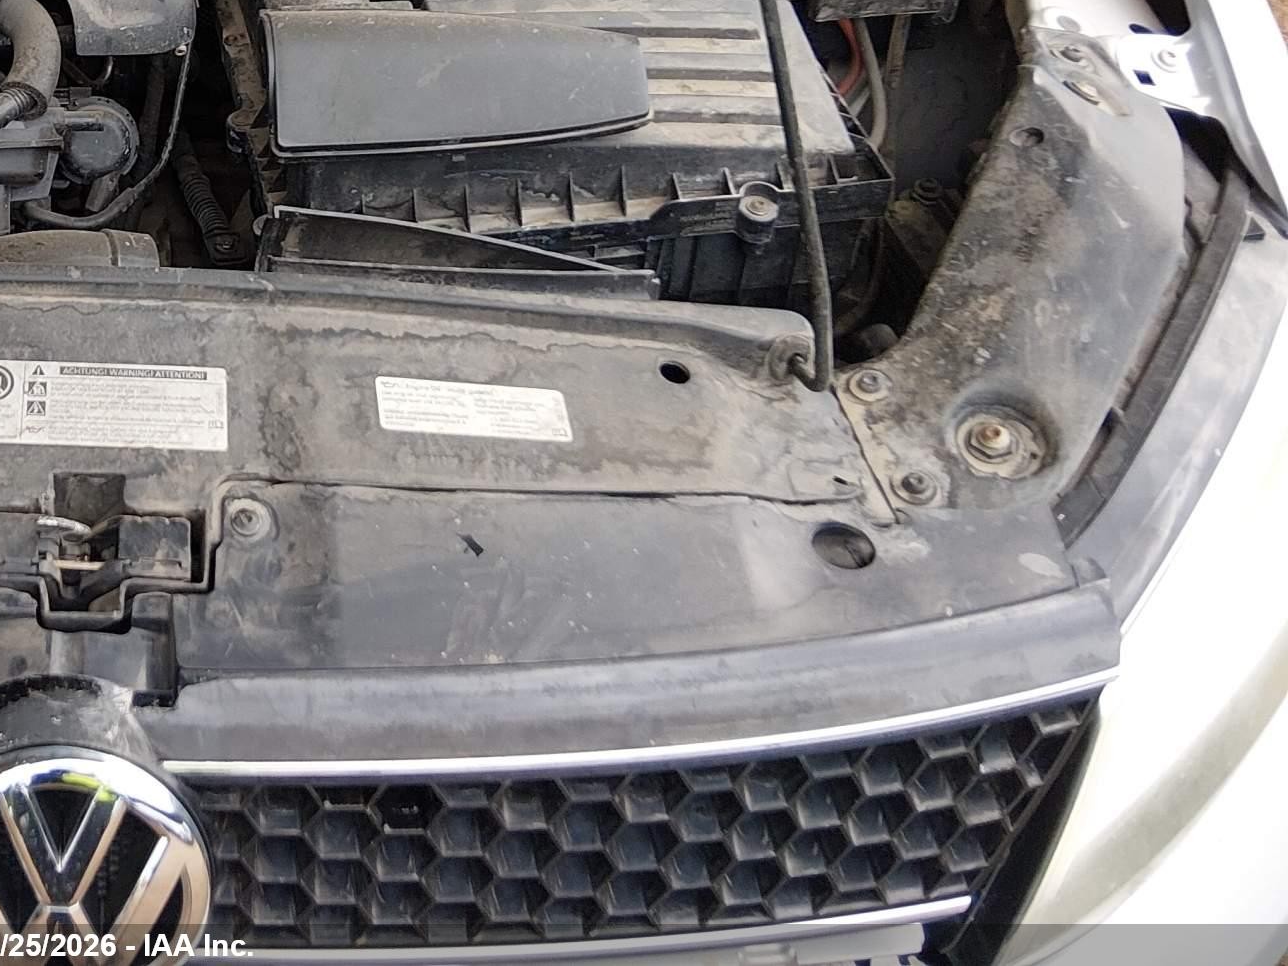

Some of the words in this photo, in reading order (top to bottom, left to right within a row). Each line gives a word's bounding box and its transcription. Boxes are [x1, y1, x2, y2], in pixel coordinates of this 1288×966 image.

[62, 367, 107, 376] ACHTUNG!
[109, 368, 153, 378] WARNING!
[155, 369, 204, 379] ATTENTION!
